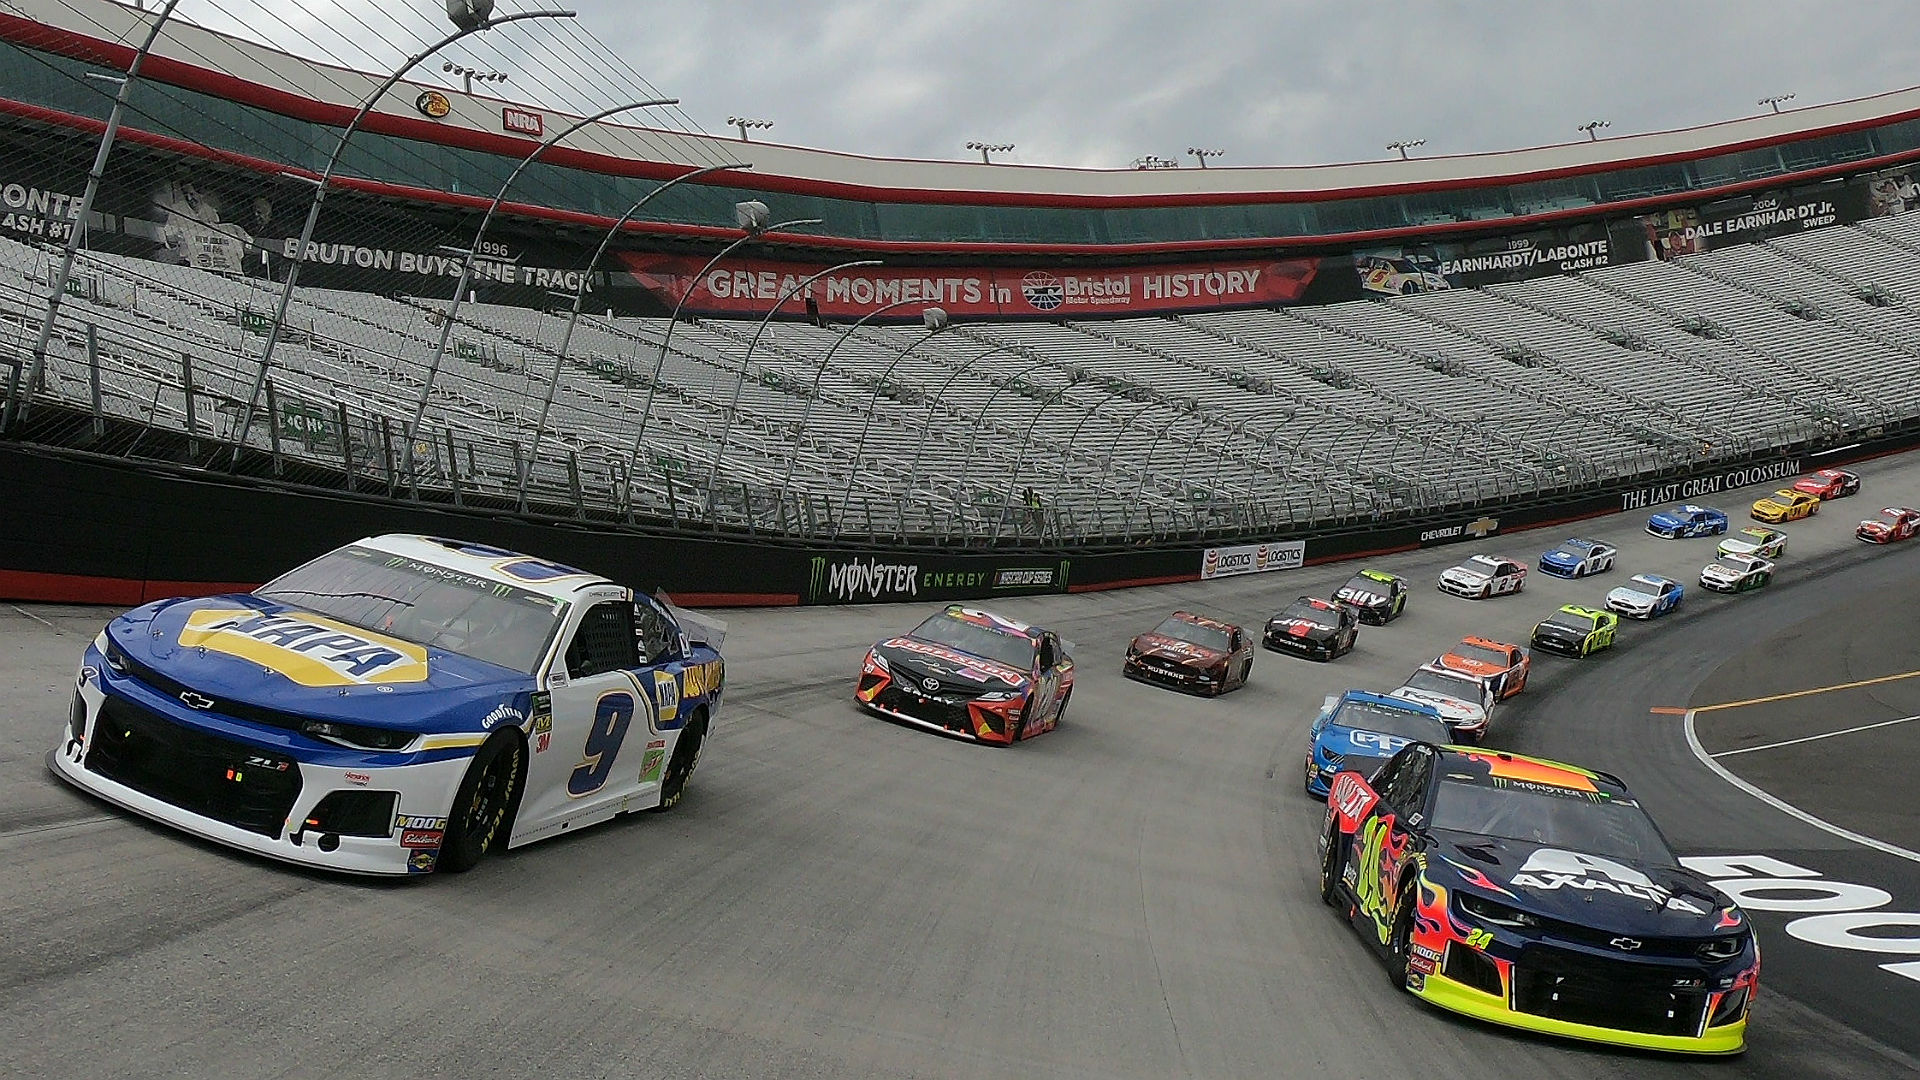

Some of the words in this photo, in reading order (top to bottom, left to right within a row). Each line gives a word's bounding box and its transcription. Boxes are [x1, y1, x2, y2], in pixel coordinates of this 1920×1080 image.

[1753, 198, 1777, 211] 2004
[1685, 221, 1724, 240] DALE
[1819, 201, 1836, 216] Jr.
[1803, 214, 1837, 230] SWEEP
[476, 240, 509, 256] 1996
[1441, 240, 1609, 276] EARNHARDT/LABONTE
[282, 236, 394, 271] BRUTON
[399, 251, 464, 278] BUYS
[472, 259, 516, 285] THE
[521, 265, 594, 293] TRACK
[1560, 257, 1593, 272] CLASH
[1595, 255, 1609, 266] #2
[706, 269, 815, 300] GREAT
[826, 277, 982, 304] MOMENTS
[988, 283, 1012, 304] in
[1064, 274, 1131, 297] Bristol
[1142, 269, 1261, 300] HISTORY
[1621, 488, 1648, 511] THE
[1649, 483, 1680, 505] LAST
[1682, 475, 1723, 498] GREAT
[1725, 459, 1801, 490] COLOSSEUM
[1420, 525, 1463, 542] CHEVROLET
[409, 562, 488, 589] MONSTER
[828, 556, 918, 601] MONSTER
[923, 572, 986, 588] ENERGY
[1498, 578, 1509, 592] 2
[1337, 588, 1387, 607] ally
[566, 690, 636, 799] 9
[1512, 780, 1583, 799] MONSTER
[396, 816, 447, 830] MOOG
[1509, 873, 1707, 916] AXALTA
[1466, 928, 1495, 950] 24
[1413, 944, 1441, 961] MOOG
